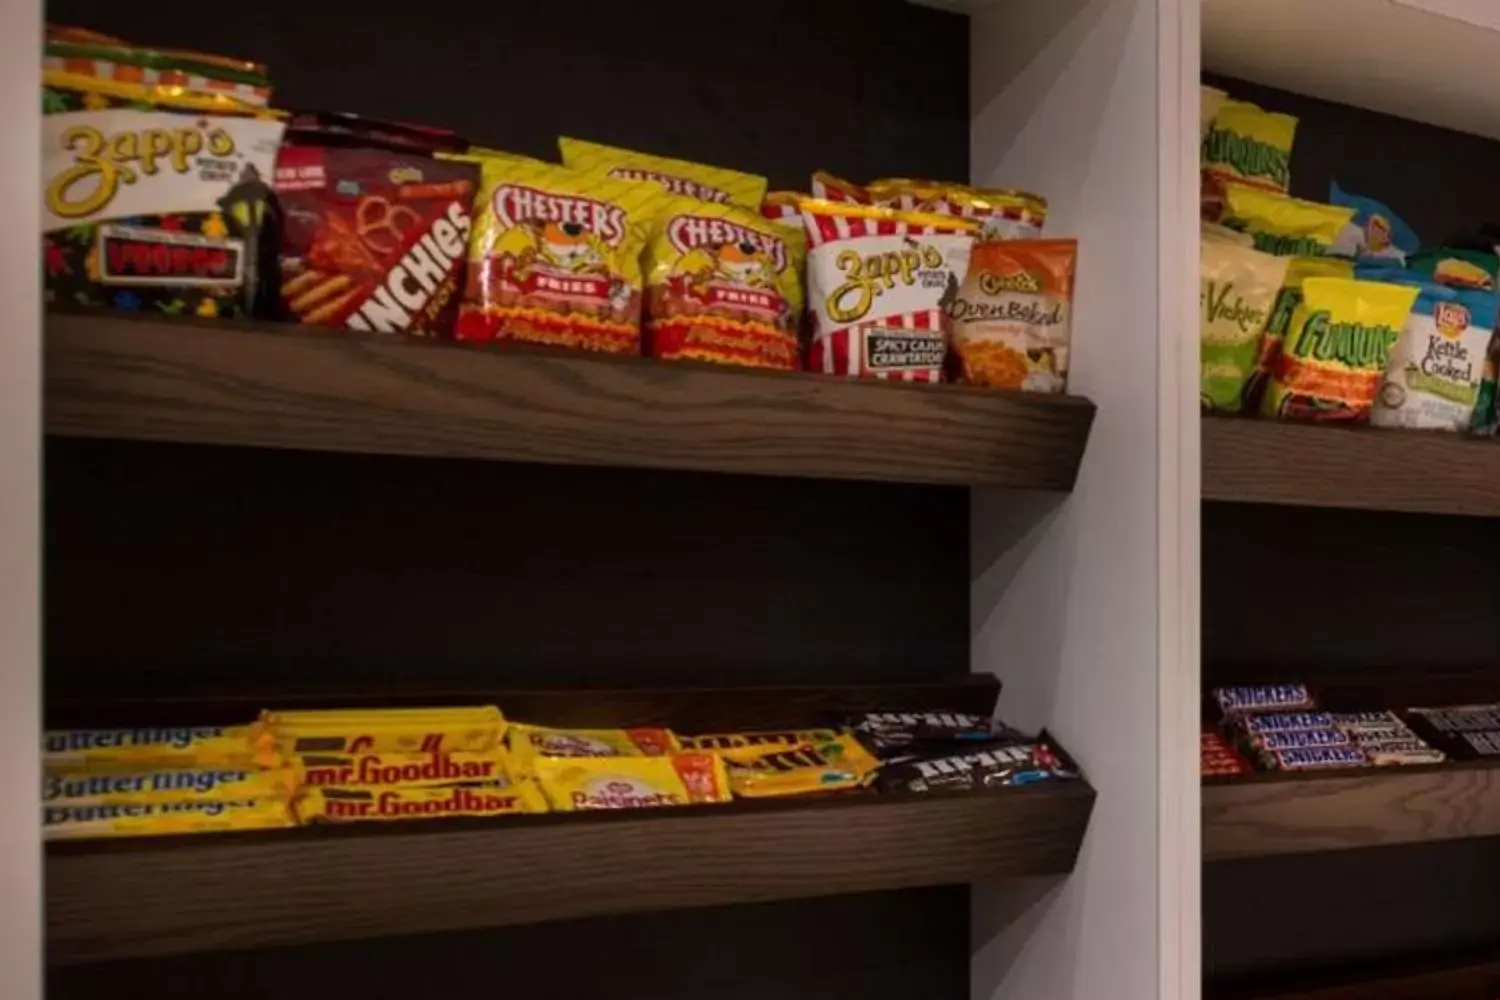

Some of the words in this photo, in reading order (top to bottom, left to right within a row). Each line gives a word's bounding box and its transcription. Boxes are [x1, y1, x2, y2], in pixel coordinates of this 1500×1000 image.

[536, 276, 596, 294] FRIES
[715, 288, 770, 305] FRIES
[1428, 335, 1468, 360] Kettle
